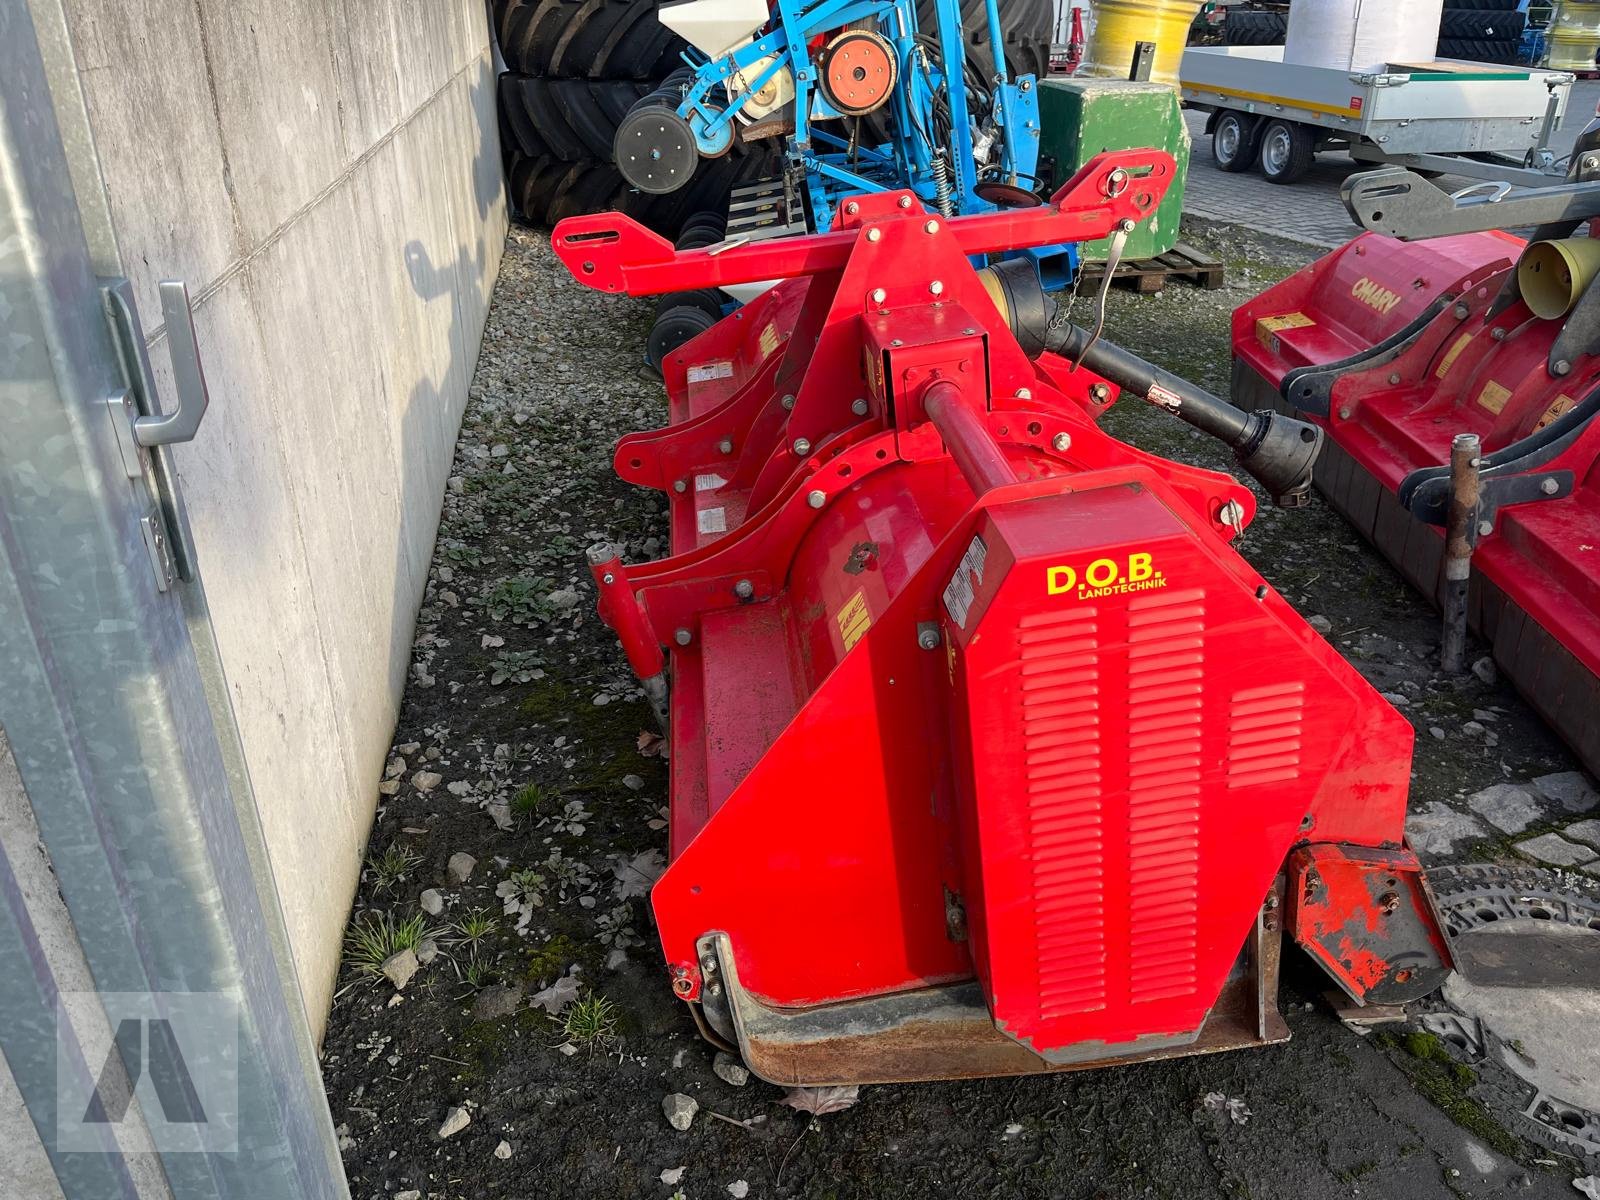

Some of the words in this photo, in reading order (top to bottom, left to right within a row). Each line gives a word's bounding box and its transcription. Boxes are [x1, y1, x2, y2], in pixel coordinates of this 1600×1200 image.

[1351, 277, 1401, 314] OMARV
[1047, 552, 1162, 595] D.O.B.
[1078, 578, 1167, 600] LANDTECHNIK
